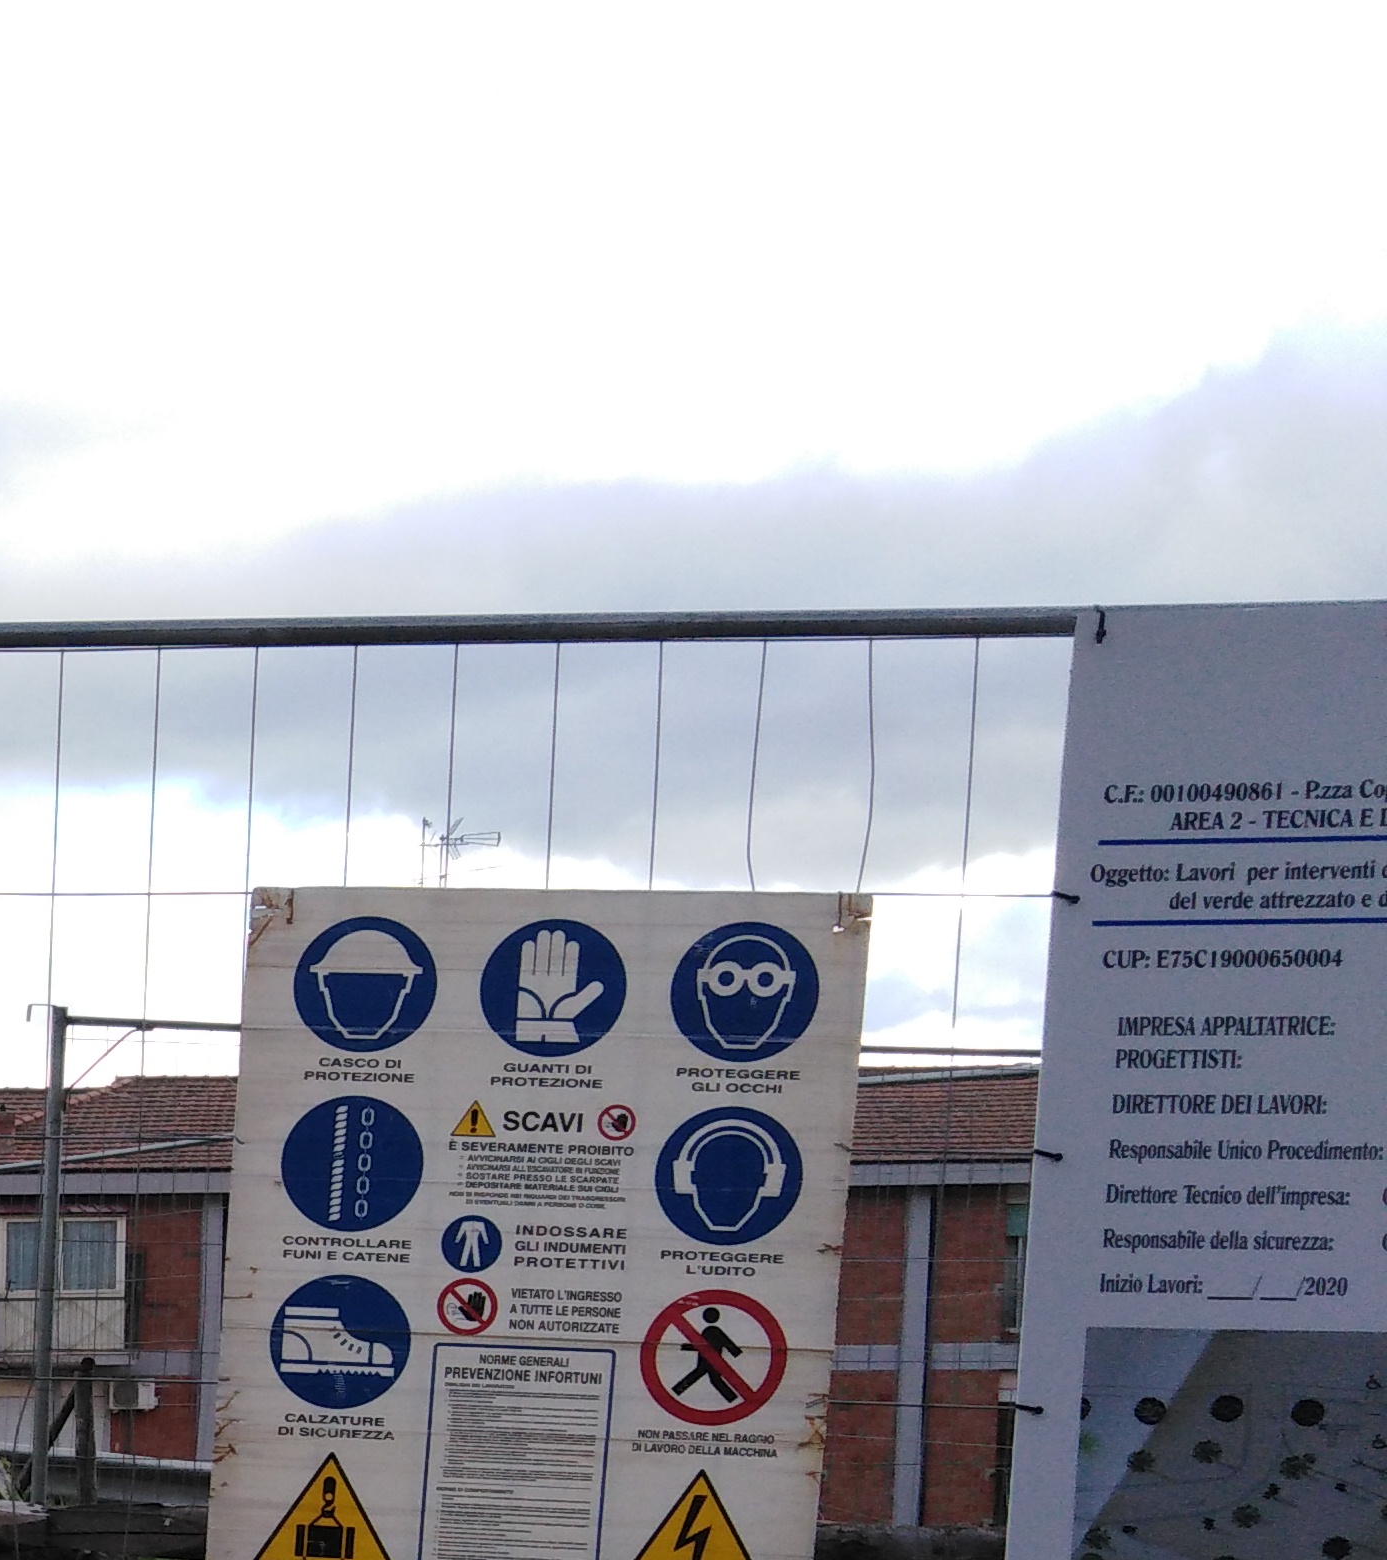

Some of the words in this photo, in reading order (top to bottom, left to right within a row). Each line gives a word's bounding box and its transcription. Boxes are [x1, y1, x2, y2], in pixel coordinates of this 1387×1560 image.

[1149, 781, 1283, 801] 00100490861
[1358, 776, 1387, 804] Co
[1168, 811, 1225, 832] AREA
[1230, 810, 1243, 829] 2
[1262, 808, 1353, 830] TECNICA
[1359, 807, 1375, 828] E
[1089, 863, 1170, 888] Oggetto:
[1175, 861, 1237, 883] Lavori
[1246, 863, 1279, 890] per
[1284, 860, 1376, 882] interventi
[1168, 889, 1198, 911] del
[1202, 888, 1253, 910] verde
[1259, 887, 1356, 909] attrezzato
[1361, 894, 1371, 908] e
[1102, 949, 1151, 971] CUP:
[1156, 948, 1343, 970] E75C19000650004
[1116, 1016, 1196, 1037] IMPRESA
[1200, 1015, 1337, 1037] APPALTATRICE:
[318, 1057, 380, 1069] CASCO
[385, 1059, 402, 1069] DI
[1115, 1049, 1243, 1070] PROGETTISTI:
[303, 1070, 415, 1083] PROTEZIONE
[503, 1062, 570, 1075] GUANTI
[575, 1064, 593, 1075] DI
[676, 1067, 801, 1081] PROTEGGERE
[490, 1076, 603, 1089] PROTEZIONE
[691, 1081, 721, 1092] GLI
[725, 1083, 783, 1095] OCCHI
[1111, 1093, 1216, 1115] DIRETTORE
[1221, 1093, 1252, 1115] DEI
[1256, 1094, 1328, 1115] LAVORI:
[502, 1110, 584, 1133] SCAVI
[461, 1141, 564, 1154] SEVERAMENTE
[567, 1144, 635, 1157] PROIBITO
[1109, 1138, 1212, 1164] Responsabile
[1217, 1139, 1263, 1160] Unico
[1267, 1139, 1385, 1162] Procedimento:
[564, 1157, 593, 1166] DEGLI
[594, 1158, 621, 1166] SCAVI
[465, 1181, 522, 1189] DEPOSITARE
[524, 1183, 575, 1192] MATERIALE
[466, 1172, 511, 1181] SOSTARE
[513, 1173, 553, 1182] PRESSO
[555, 1175, 567, 1183] LE
[569, 1175, 620, 1185] SCARPATE
[1105, 1183, 1178, 1205] Direttore
[1183, 1184, 1242, 1206] Tecnico
[1246, 1185, 1351, 1211] dell'impresa:
[515, 1224, 627, 1240] INDOSSARE
[282, 1235, 412, 1250] CONTROLLARE
[514, 1240, 539, 1252] GLI
[543, 1241, 627, 1256] INDUMENTI
[1102, 1228, 1206, 1254] Responsabile
[1209, 1230, 1248, 1251] della
[1253, 1230, 1334, 1252] sicurezza:
[282, 1249, 322, 1260] FUNI
[326, 1250, 338, 1261] E
[342, 1251, 411, 1264] CATENE
[513, 1256, 625, 1271] PROTETTIVI
[660, 1249, 785, 1264] PROTEGGERE
[685, 1264, 756, 1277] L'UDITO
[1099, 1272, 1144, 1295] Inizio
[1147, 1274, 1204, 1296] Lavori:
[510, 1287, 555, 1300] VIETATO
[557, 1289, 623, 1303] L'INGRESSO
[509, 1303, 518, 1315] A
[520, 1303, 553, 1316] TUTTE
[555, 1305, 569, 1317] LE
[571, 1306, 622, 1319] PERSONE
[508, 1318, 535, 1331] NON
[538, 1320, 620, 1335] AUTORIZZATE
[479, 1353, 517, 1366] NORME
[519, 1355, 570, 1368] GENERALI
[444, 1366, 531, 1382] PREVENZIONE
[535, 1370, 603, 1385] INFORTUNI
[284, 1413, 385, 1427] CALZATURE
[277, 1426, 294, 1436] DI
[298, 1427, 395, 1441] SICUREZZA
[637, 1429, 660, 1440] NON
[662, 1430, 710, 1442] PASSARE
[711, 1432, 732, 1443] NEL
[733, 1433, 775, 1444] RAGGIO
[631, 1442, 642, 1452] DI
[644, 1443, 686, 1454] LAVORO
[688, 1445, 721, 1456] DELLA
[723, 1446, 778, 1458] MACCHINA
